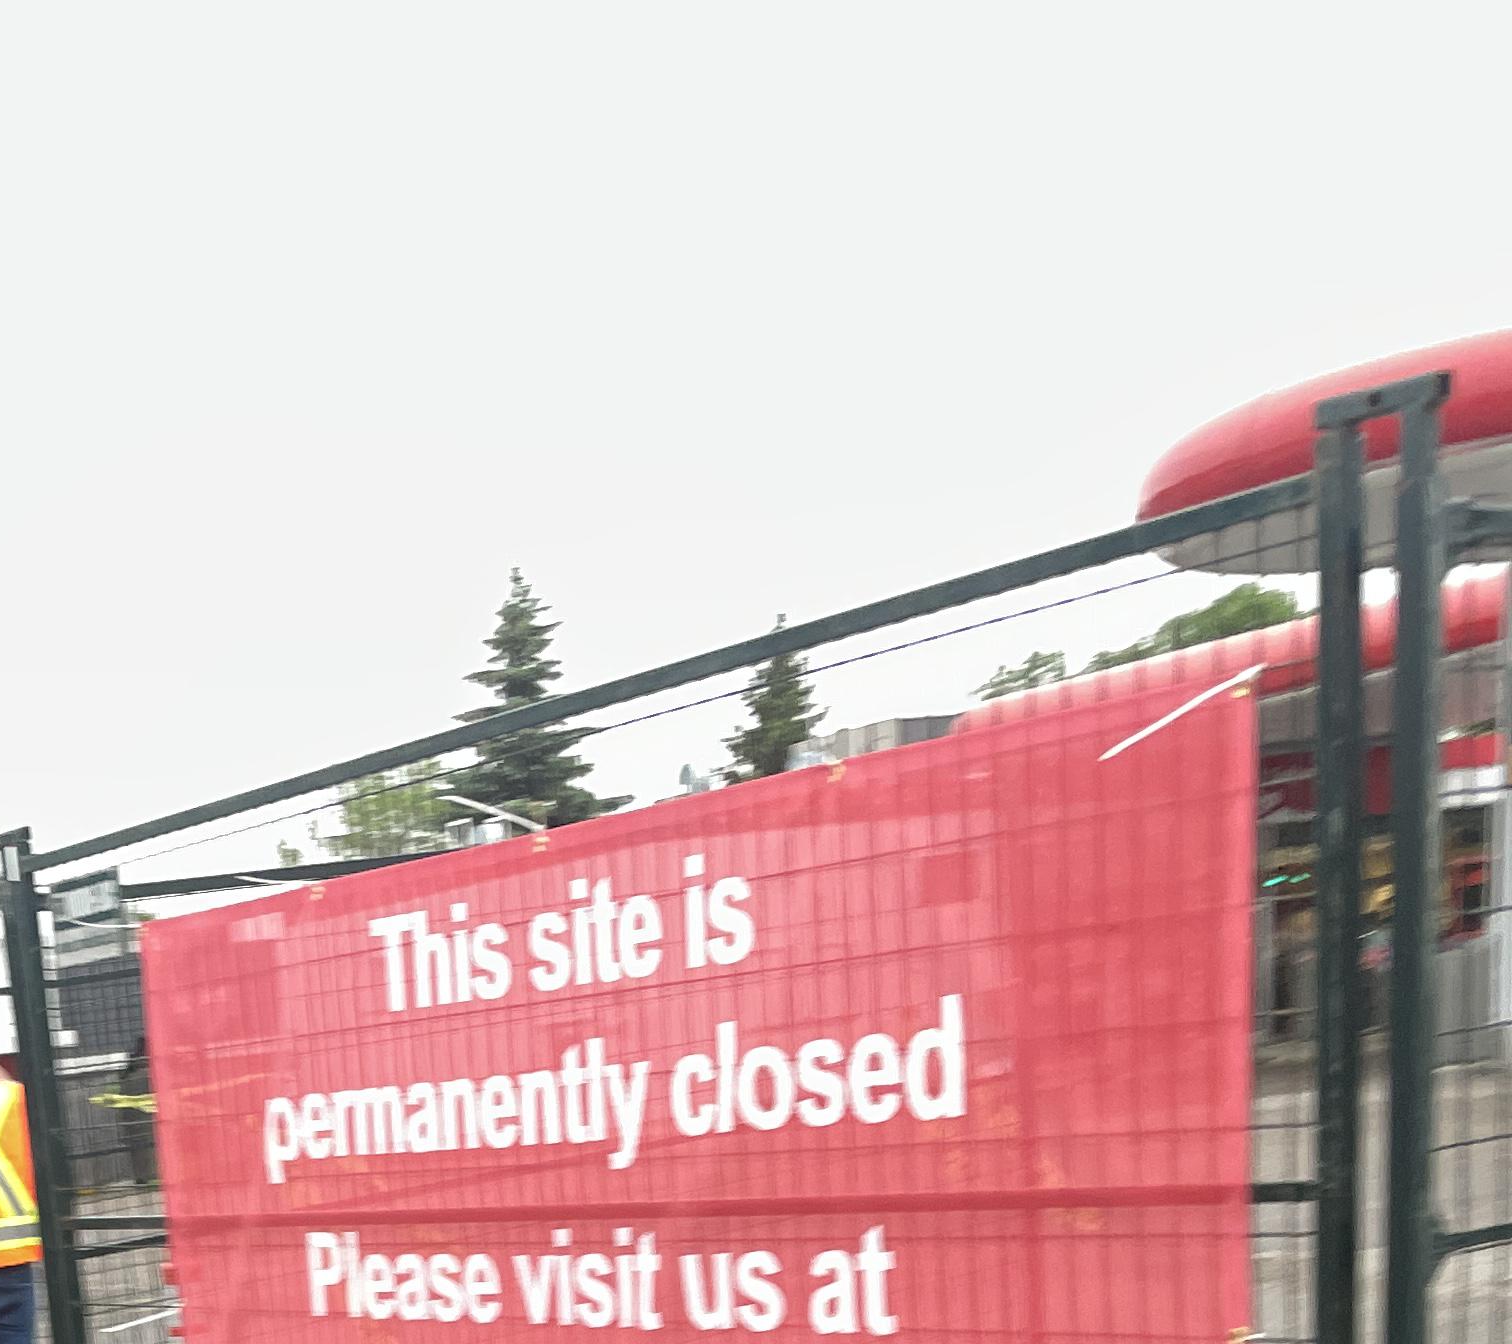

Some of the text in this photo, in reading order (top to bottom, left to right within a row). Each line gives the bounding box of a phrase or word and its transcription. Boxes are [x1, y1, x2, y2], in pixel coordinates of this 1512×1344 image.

[368, 854, 755, 1011] This site is
[265, 994, 964, 1183] permanently closed
[306, 1227, 896, 1335] Please visit us at
